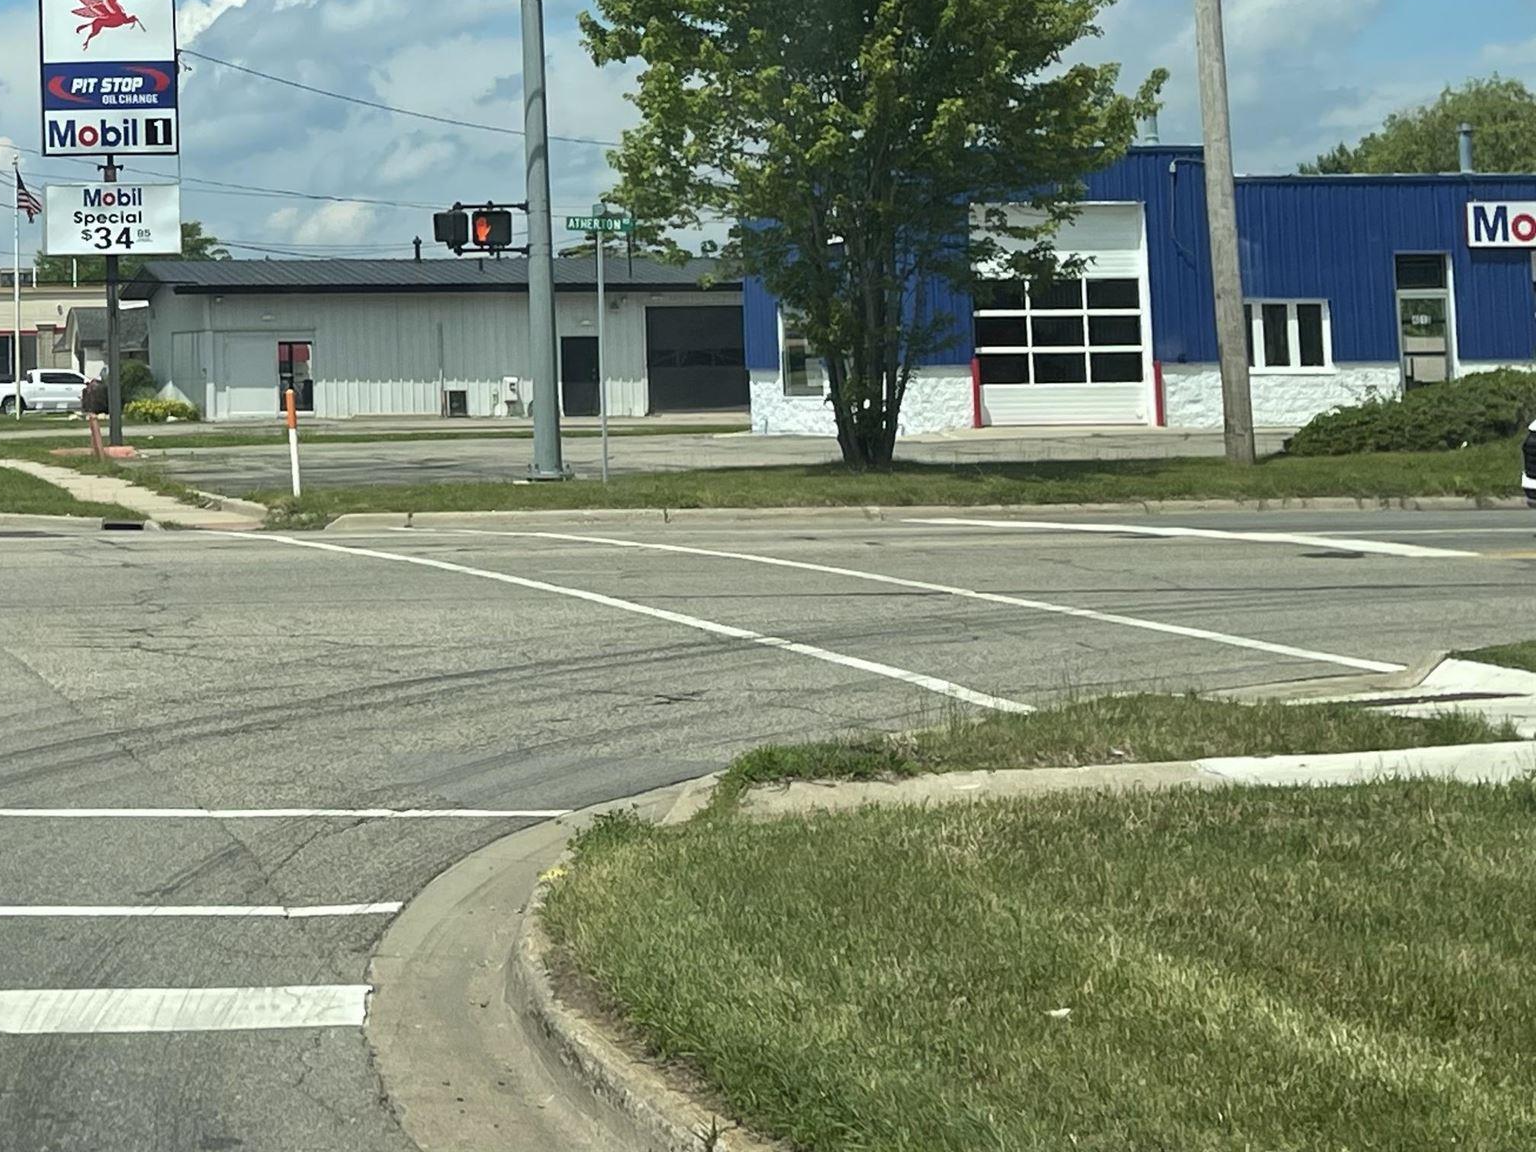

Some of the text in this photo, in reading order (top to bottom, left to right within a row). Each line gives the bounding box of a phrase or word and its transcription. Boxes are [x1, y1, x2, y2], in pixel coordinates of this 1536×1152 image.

[71, 77, 144, 93] PIT STOP
[102, 93, 159, 105] OIL CHANGE
[48, 118, 138, 148] Mobil
[83, 187, 142, 207] Mobil
[73, 210, 142, 227] Special
[568, 218, 621, 230] ATHERTON
